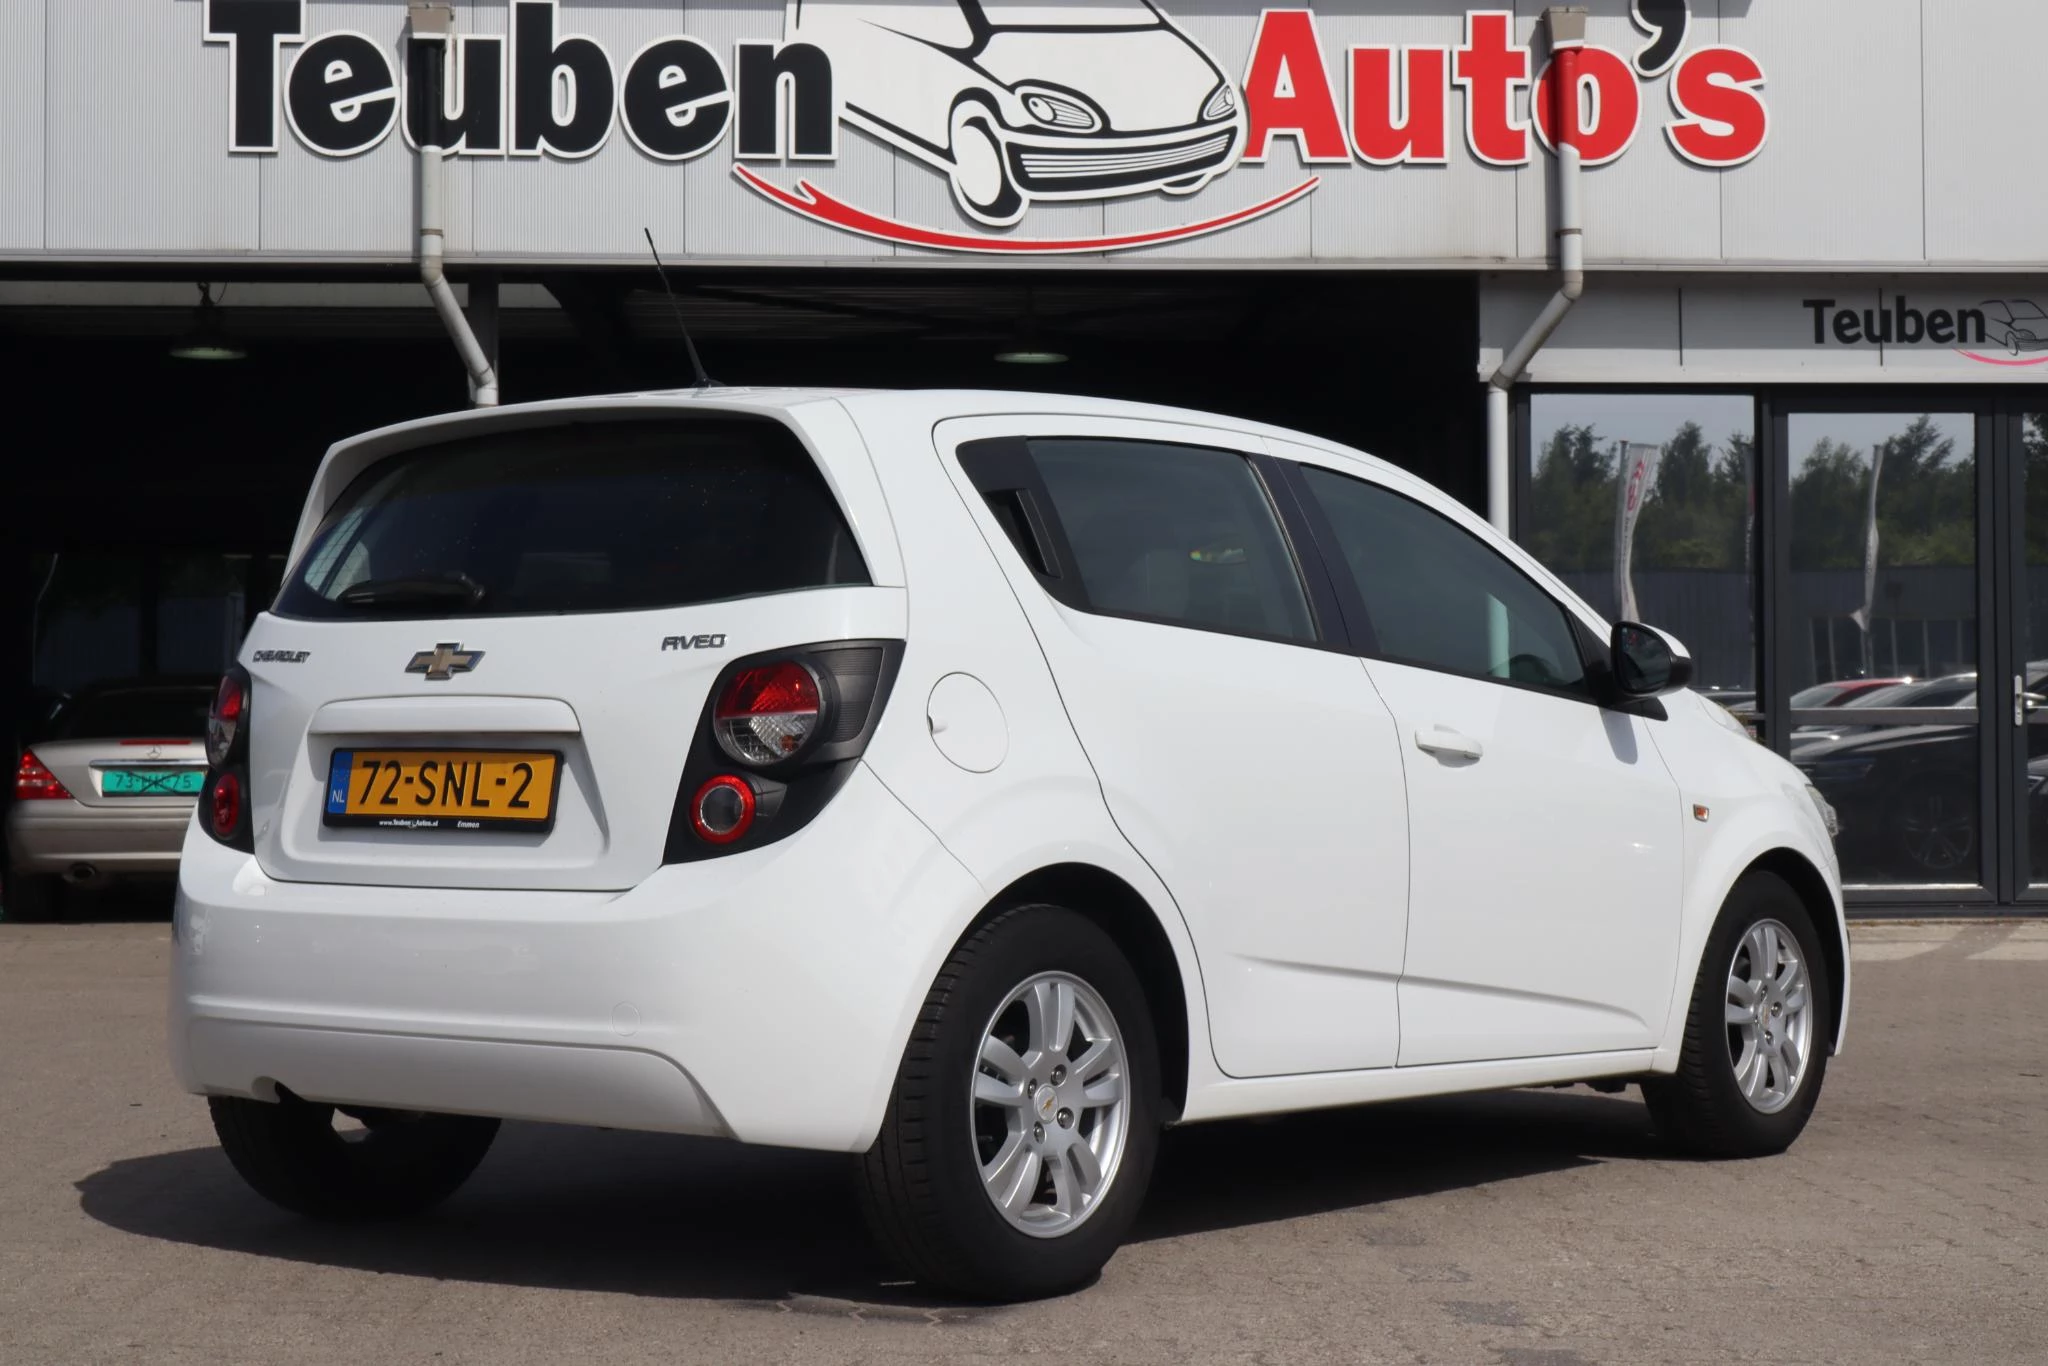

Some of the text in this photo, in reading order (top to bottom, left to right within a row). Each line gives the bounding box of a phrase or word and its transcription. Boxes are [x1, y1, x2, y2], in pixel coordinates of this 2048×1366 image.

[205, 0, 1771, 167] Teuben Auto's
[1802, 295, 1986, 344] Teuben
[252, 650, 311, 664] CHEVROLET
[661, 633, 726, 651] AVEO
[331, 760, 534, 809] NL 72-SNL-2
